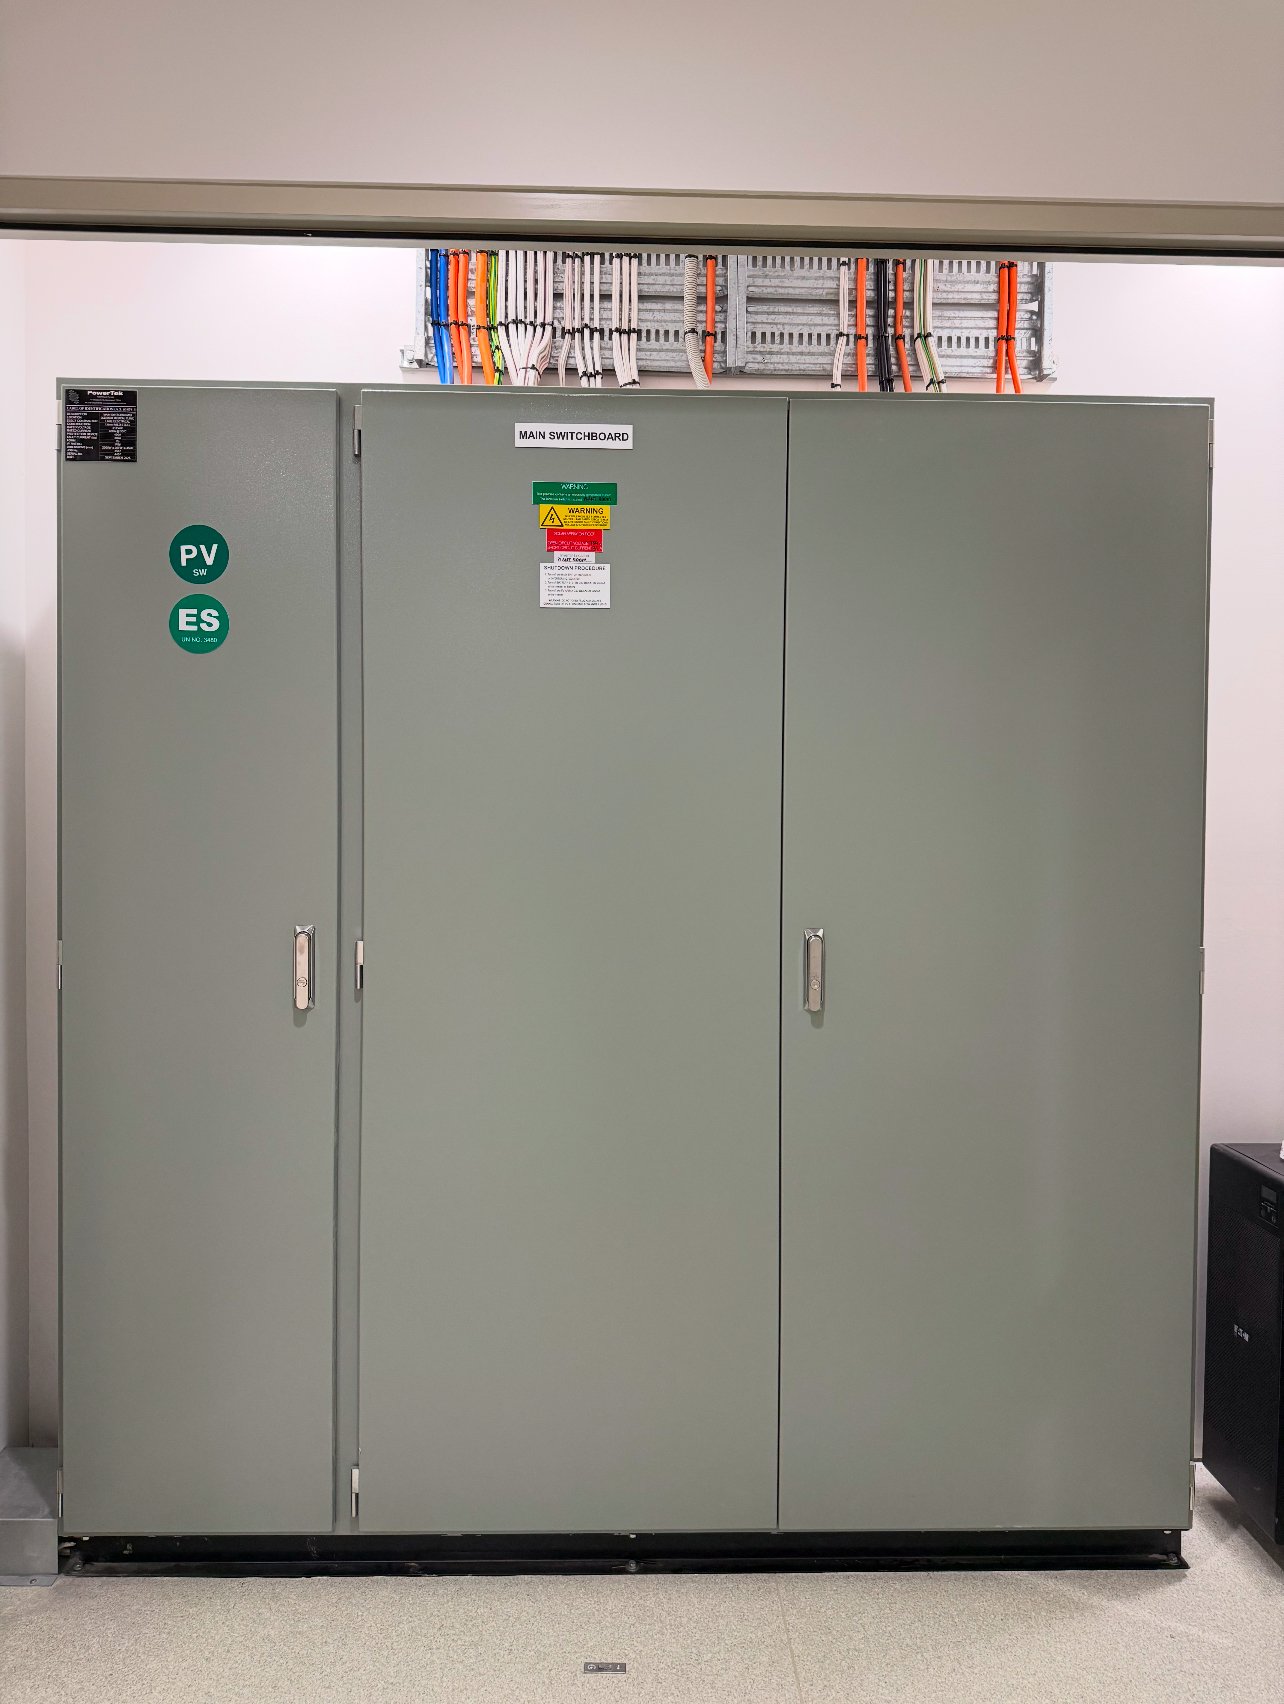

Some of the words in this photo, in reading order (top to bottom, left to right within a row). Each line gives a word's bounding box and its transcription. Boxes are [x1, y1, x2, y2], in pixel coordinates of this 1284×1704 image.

[519, 430, 546, 440] MAIN
[548, 431, 629, 442] SWITCHBOARD
[567, 507, 604, 515] WARNING
[180, 543, 218, 567] PV
[193, 568, 207, 577] SW
[178, 608, 220, 632] ES
